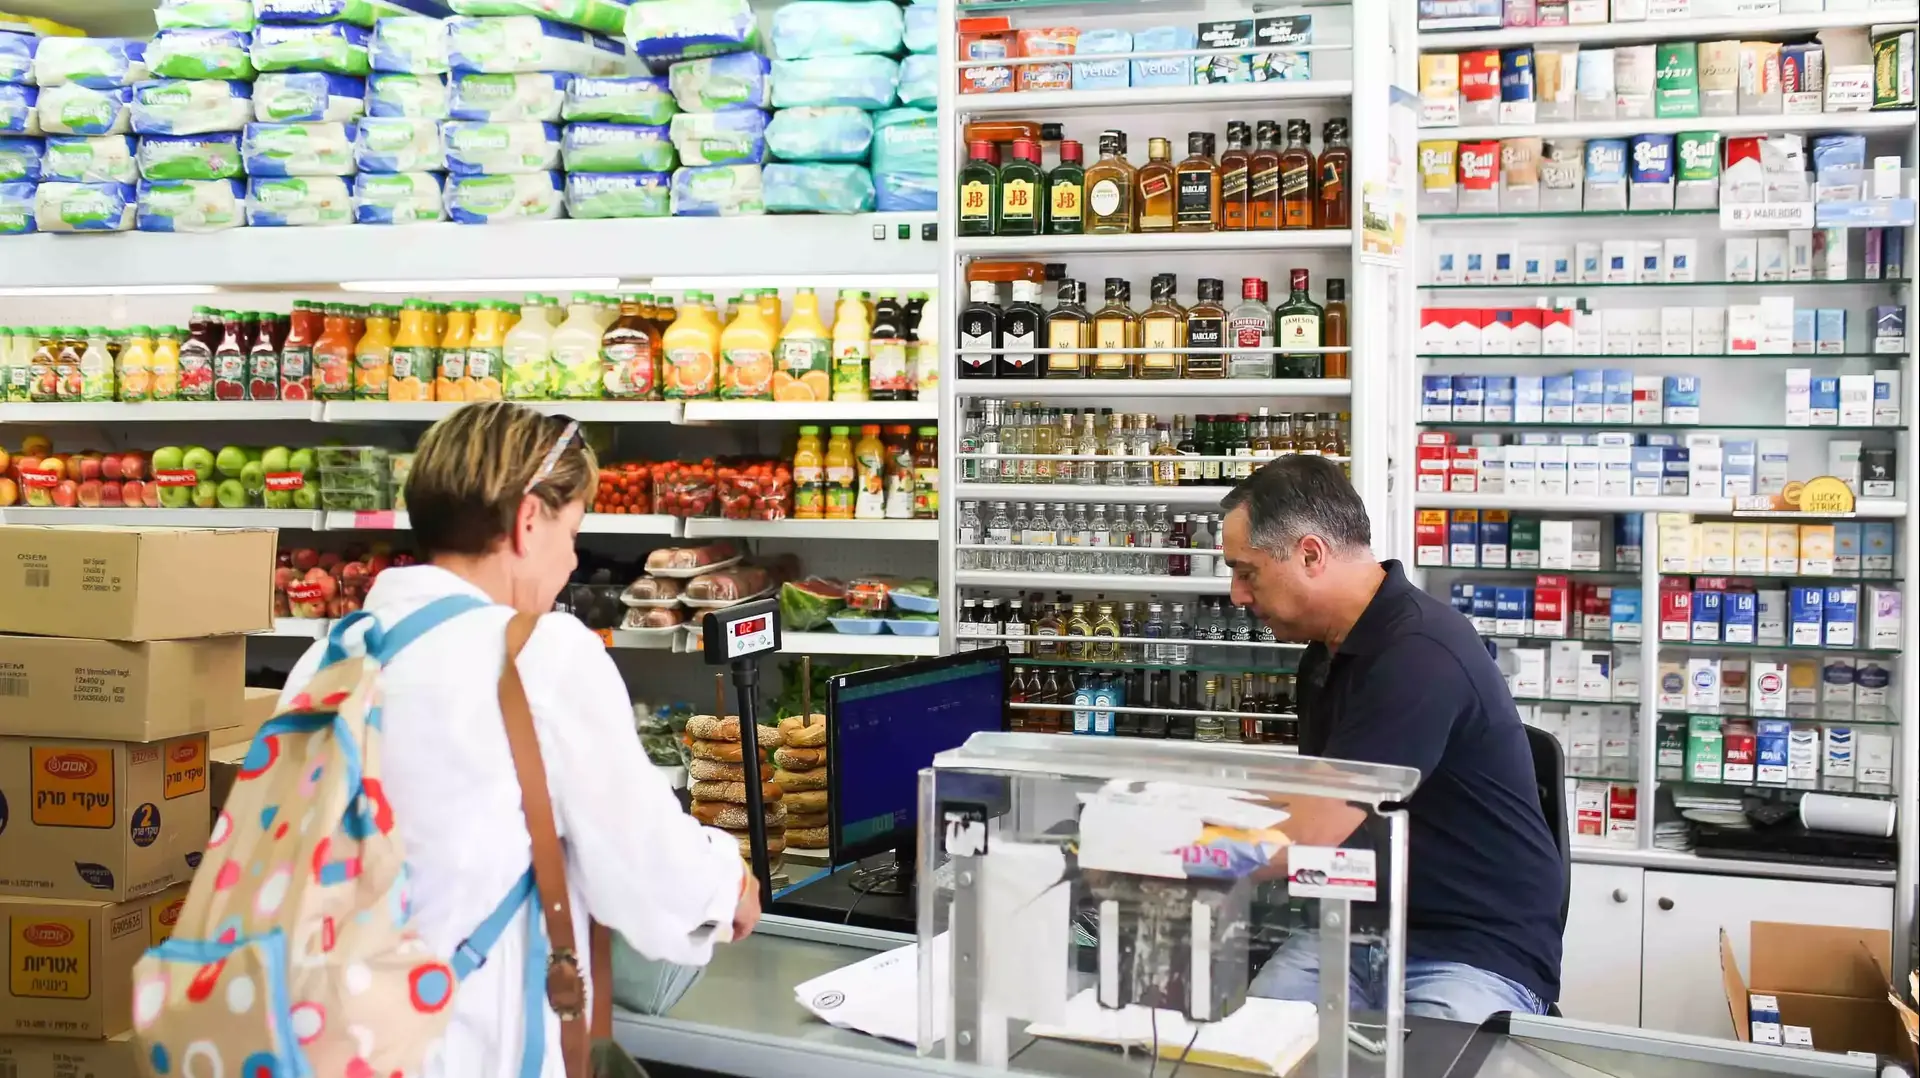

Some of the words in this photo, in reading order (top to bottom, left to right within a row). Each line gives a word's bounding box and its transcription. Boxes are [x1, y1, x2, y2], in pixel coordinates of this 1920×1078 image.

[1080, 62, 1118, 79] Venus
[1138, 60, 1180, 77] Venus
[61, 761, 87, 773] אסם
[184, 766, 203, 783] שקדי
[166, 771, 182, 789] מרק
[37, 790, 66, 809] מרק
[72, 791, 110, 812] שקדי
[140, 804, 153, 827] 2
[23, 956, 78, 974] אטריות
